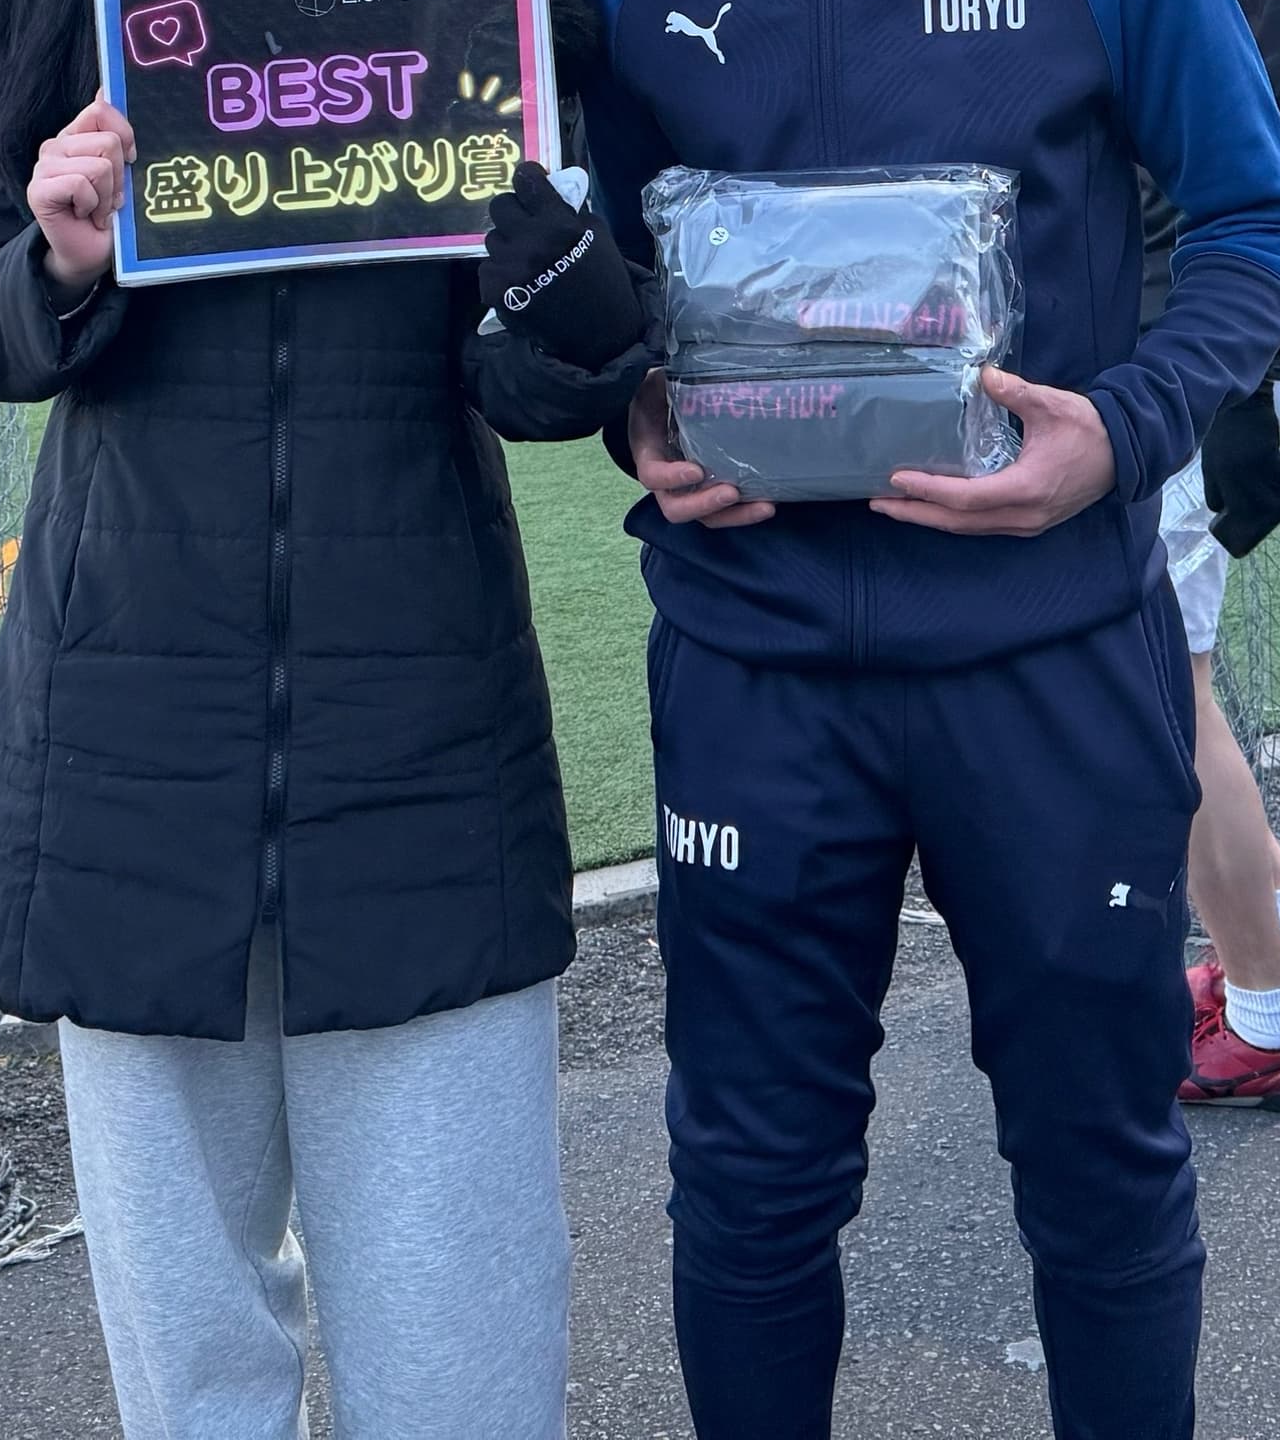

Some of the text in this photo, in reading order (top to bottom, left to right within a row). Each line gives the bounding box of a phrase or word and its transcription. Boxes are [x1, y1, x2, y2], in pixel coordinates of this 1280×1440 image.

[206, 50, 429, 133] BEST
[145, 133, 521, 224] 盛り上がり賞
[663, 803, 740, 872] TOKYO
